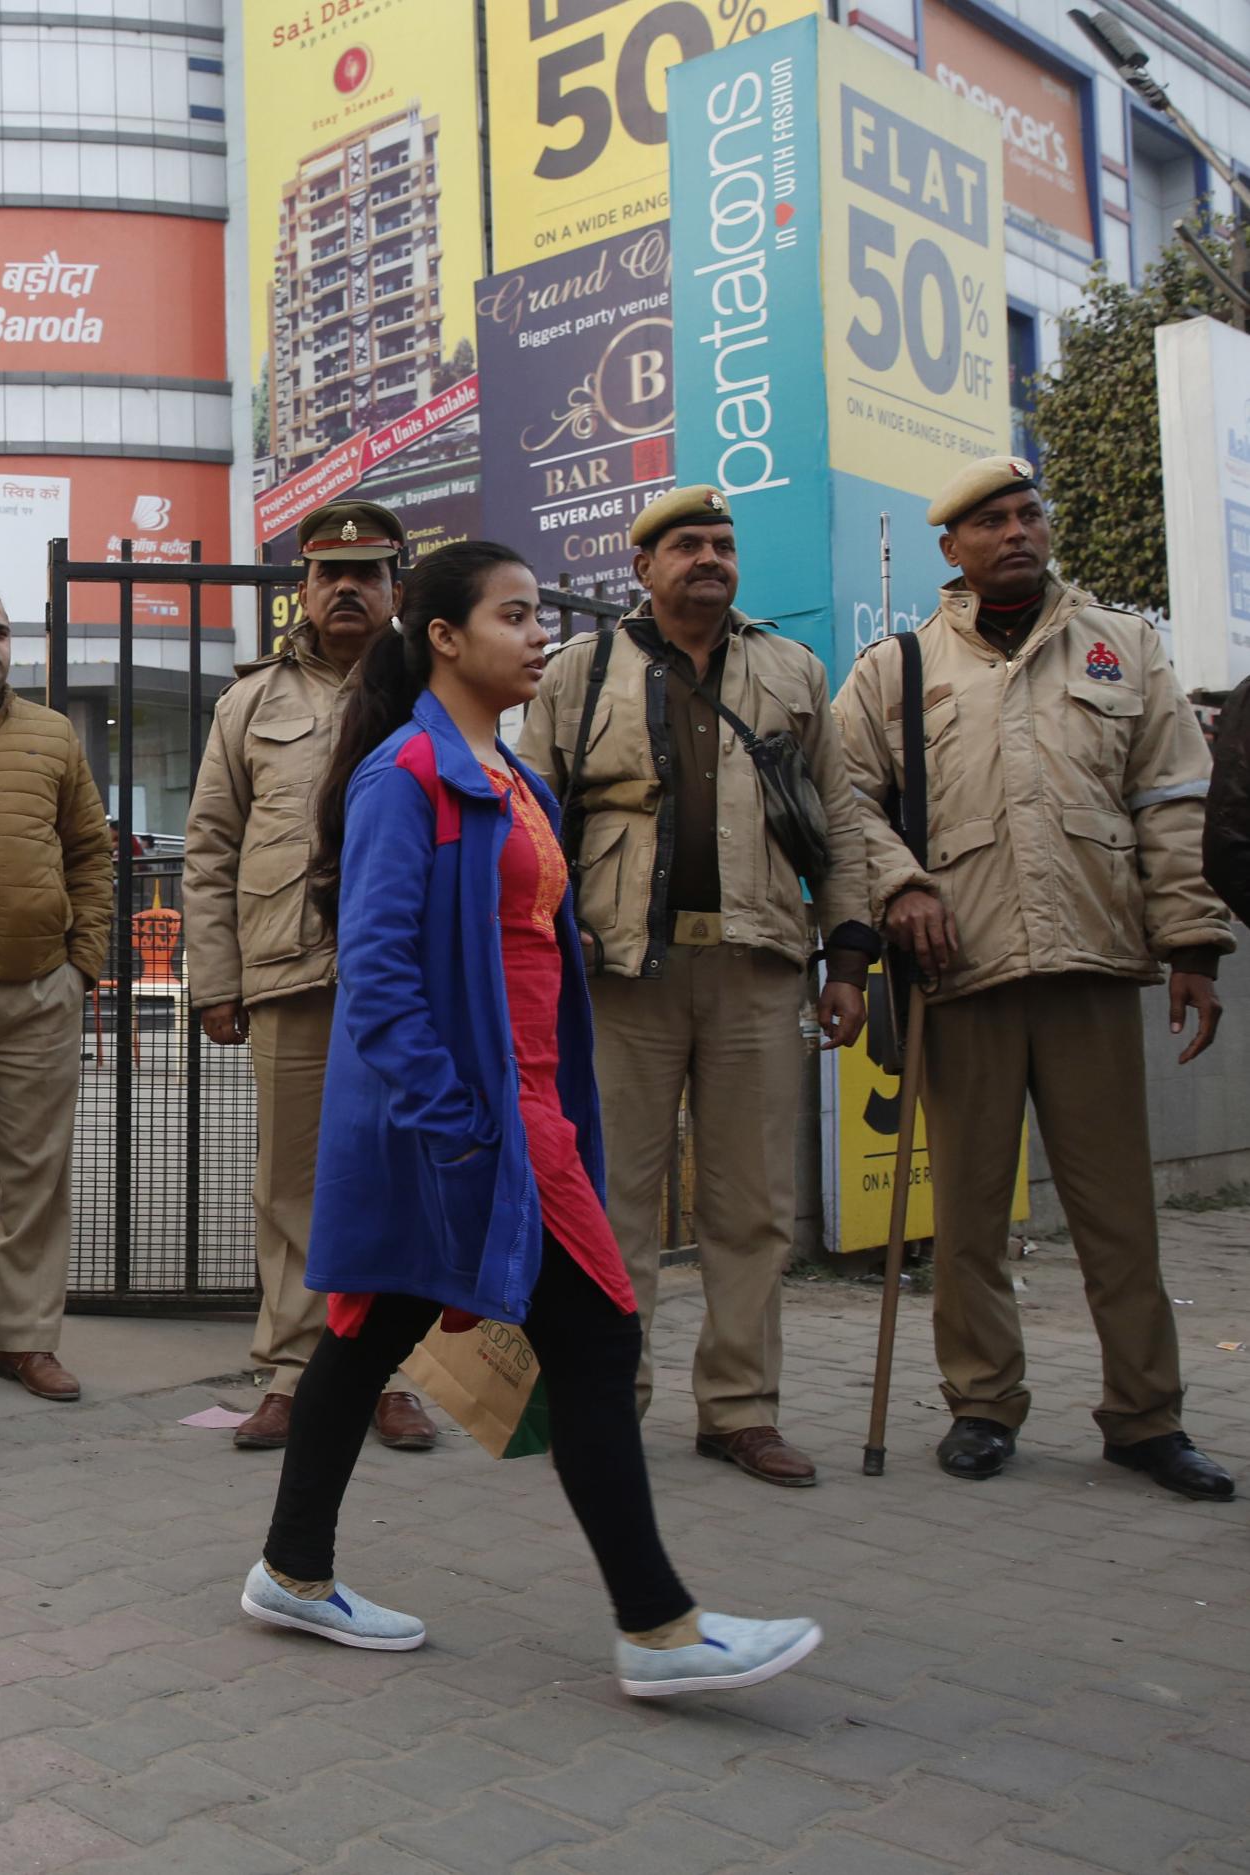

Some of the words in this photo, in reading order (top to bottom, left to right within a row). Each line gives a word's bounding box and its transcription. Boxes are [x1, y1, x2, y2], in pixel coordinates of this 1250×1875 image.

[272, 11, 315, 48] Sai
[320, 0, 366, 25] Da
[533, 1, 715, 181] 50
[770, 56, 795, 143] FASHION
[312, 113, 339, 131] Stay
[772, 144, 796, 200] WITH
[852, 105, 978, 227] FLAT
[534, 231, 557, 248] ON
[561, 225, 571, 240] A
[575, 208, 618, 235] WIDE
[1, 249, 100, 301] बड़ौदा
[477, 250, 612, 336] Grand
[693, 71, 791, 498] pantaloons
[846, 203, 962, 396] 50
[518, 318, 572, 348] Biggest
[575, 305, 617, 335] party
[619, 291, 670, 318] venue
[962, 275, 989, 339] %
[626, 347, 668, 405] B
[963, 351, 993, 401] OFF
[369, 438, 392, 459] Few
[392, 418, 425, 444] Units
[424, 383, 478, 428] Available
[846, 396, 864, 418] ON
[866, 404, 875, 422] A
[877, 407, 906, 433] WIDE
[907, 418, 942, 445] RANGE
[943, 431, 958, 449] OF
[39, 484, 61, 500] करें
[259, 488, 295, 517] Project
[295, 451, 350, 496] Completed
[349, 445, 360, 459] &
[262, 493, 317, 533] Possession
[317, 466, 355, 497] Started
[405, 484, 450, 507] Dayanand
[450, 480, 477, 497] Marg
[544, 456, 612, 498] BAR
[539, 498, 624, 532] BEVERAGE
[563, 523, 640, 562] Comi
[577, 572, 594, 586] this
[595, 569, 616, 581] NYE
[863, 1172, 880, 1192] ON
[881, 1171, 891, 1190] A
